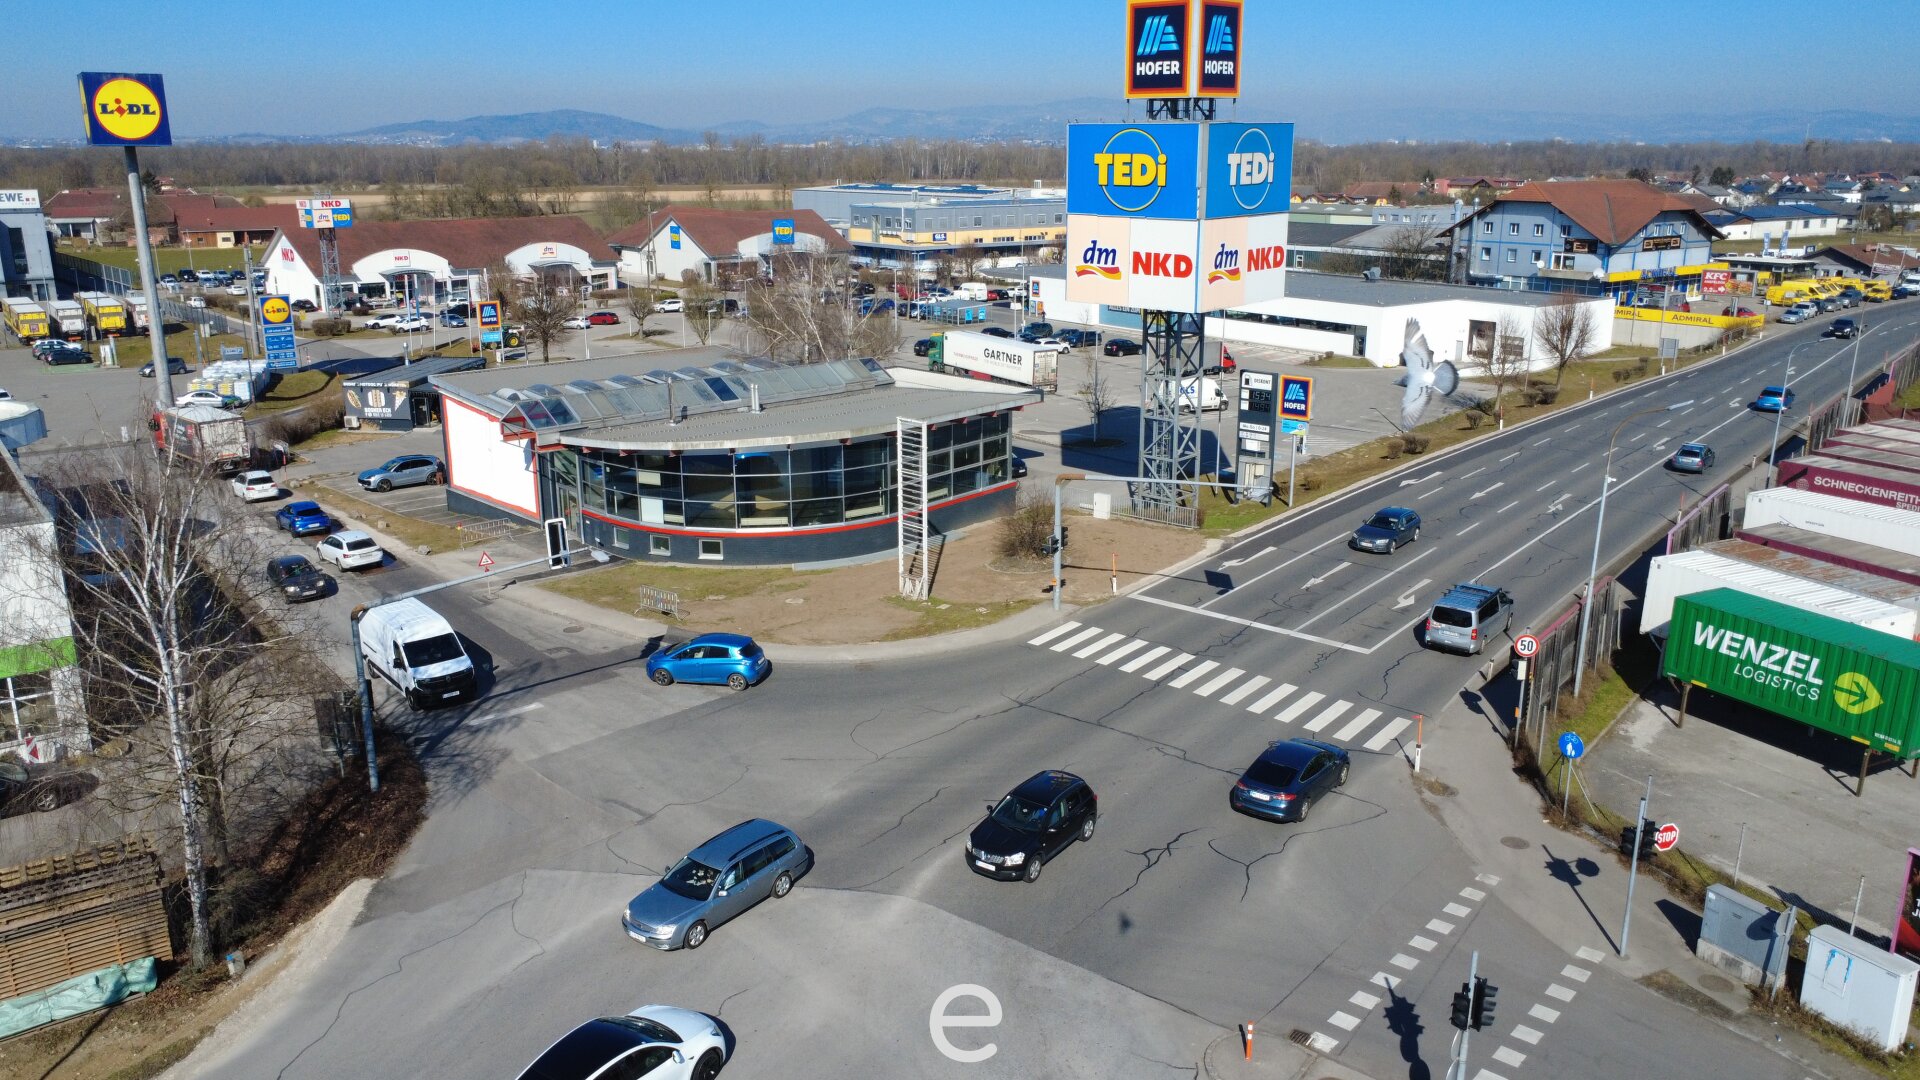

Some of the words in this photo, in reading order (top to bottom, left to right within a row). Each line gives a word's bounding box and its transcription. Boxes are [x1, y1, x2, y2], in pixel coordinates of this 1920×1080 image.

[1136, 60, 1180, 75] HOFER
[1204, 60, 1234, 75] HOFER
[1094, 152, 1168, 187] TEDi
[1227, 151, 1275, 186] TEDi
[281, 248, 295, 262] NKD
[1083, 239, 1117, 266] dm
[1214, 243, 1239, 270] dm
[1247, 245, 1285, 272] NKD
[1132, 251, 1193, 278] NKD
[1704, 272, 1728, 280] KFC
[1672, 313, 1714, 324] ADMIRAL
[984, 348, 1022, 366] GARTNER
[1284, 401, 1306, 411] HOFER
[1520, 640, 1533, 651] 50
[1693, 621, 1824, 685] WENZEL
[1733, 663, 1820, 700] LOGISTICS
[1658, 831, 1676, 843] STOP
